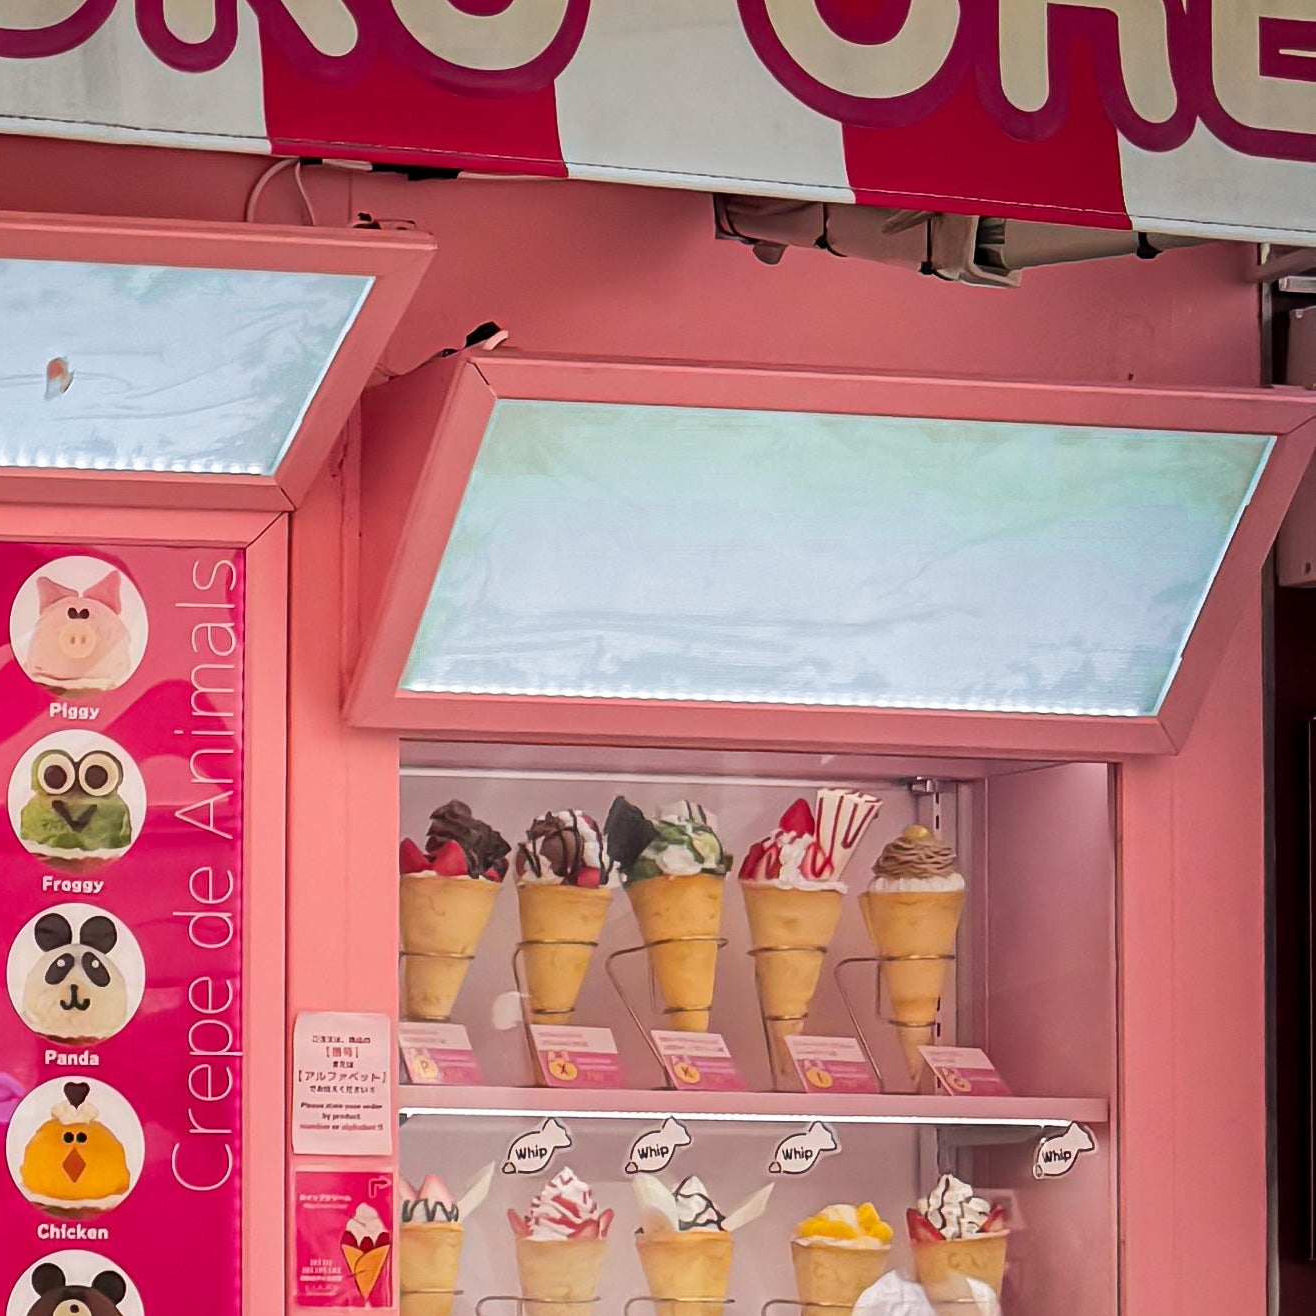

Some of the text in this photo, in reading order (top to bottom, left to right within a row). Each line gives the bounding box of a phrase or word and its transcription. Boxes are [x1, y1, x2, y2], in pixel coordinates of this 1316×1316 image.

[49, 702, 101, 720] Piggy
[171, 558, 244, 1192] Crepe de Animals
[42, 875, 105, 894] Froggy
[44, 1049, 100, 1066] Panda
[514, 1145, 549, 1161] Whip
[637, 1143, 670, 1160] Whip
[782, 1146, 814, 1161] Whip
[37, 1223, 109, 1241] Chicken
